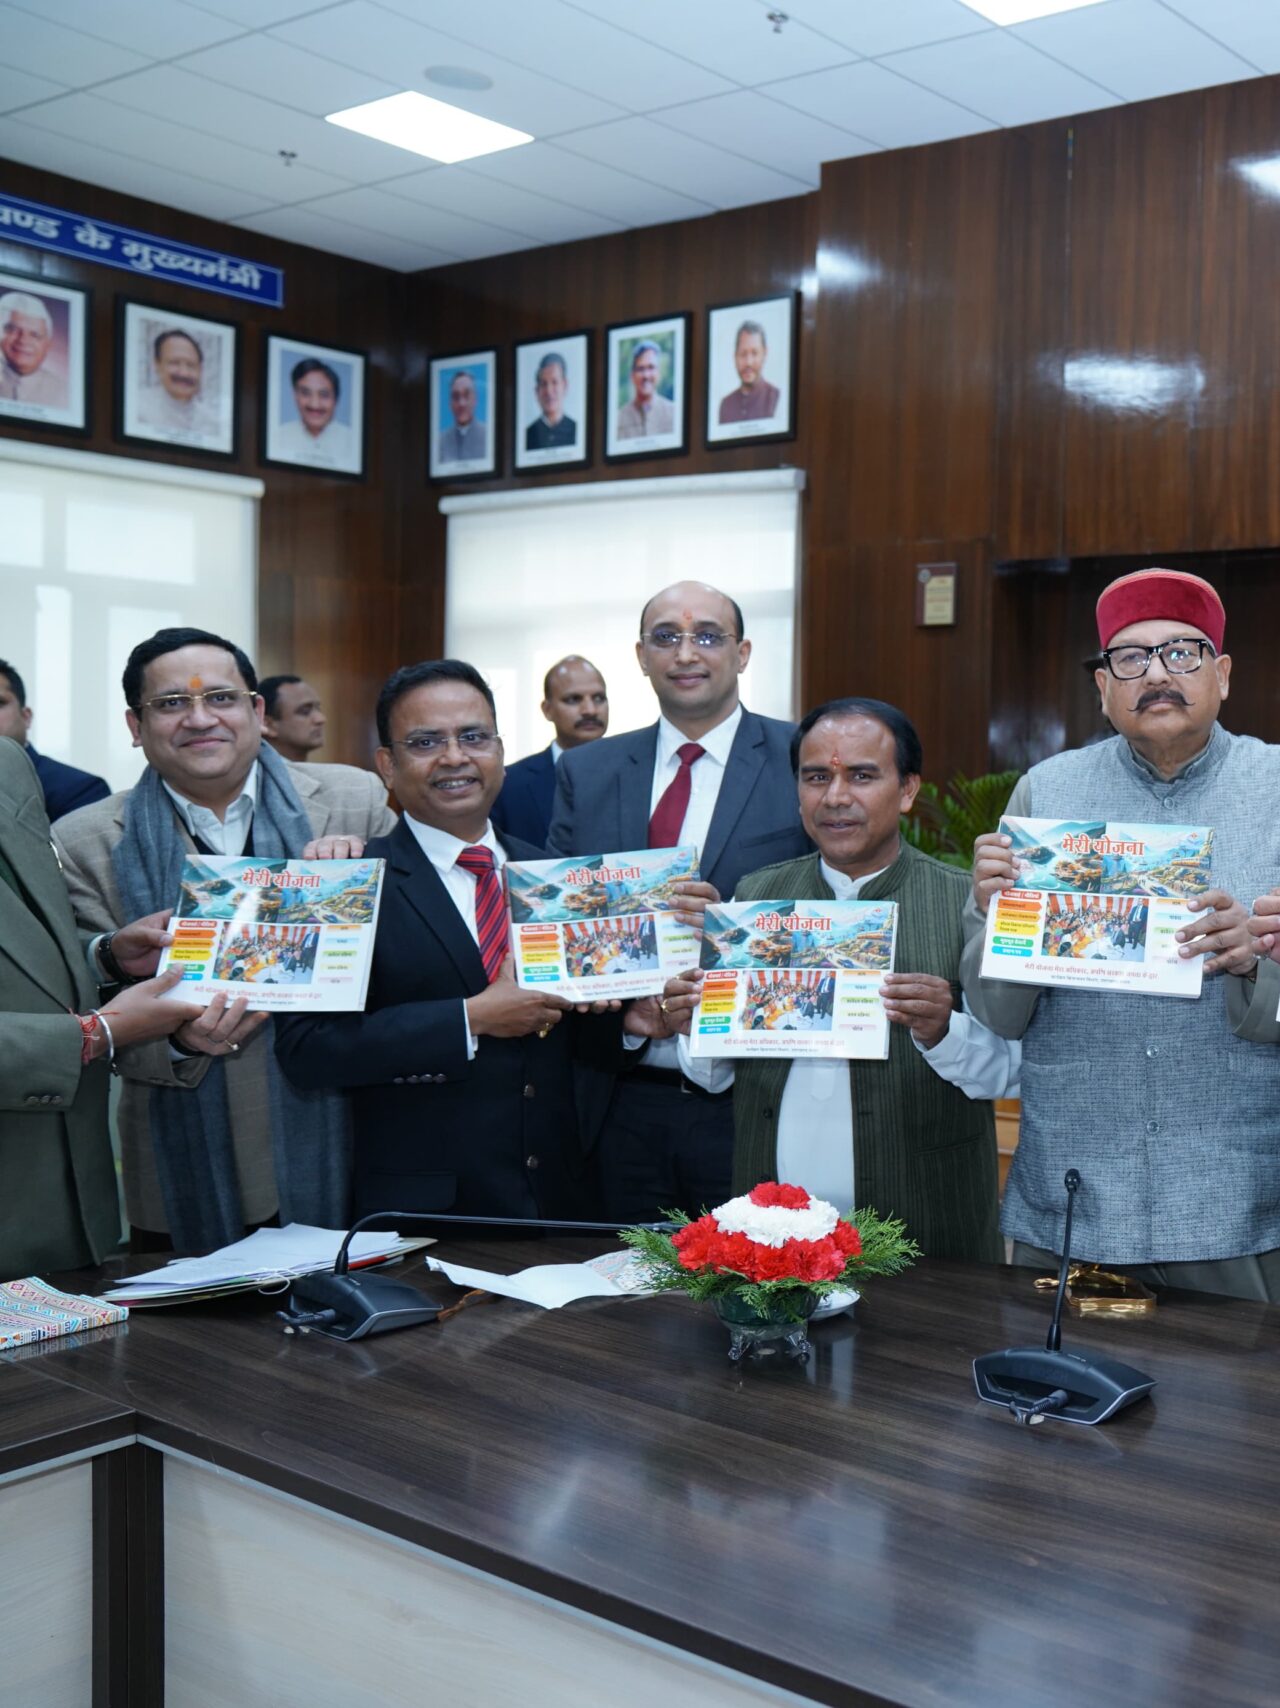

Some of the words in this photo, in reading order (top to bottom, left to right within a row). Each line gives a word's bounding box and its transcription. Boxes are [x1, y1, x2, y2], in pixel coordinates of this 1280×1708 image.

[74, 222, 115, 250] के
[121, 238, 263, 290] मुख्यमंत्री
[1062, 833, 1090, 854] मेरी
[1093, 834, 1145, 856] योजना
[242, 868, 271, 888] मेरी
[273, 870, 321, 888] योजना
[566, 867, 593, 886] मेरी
[594, 865, 641, 884] योजना
[756, 912, 780, 930] मेरी
[783, 912, 832, 931] योजना
